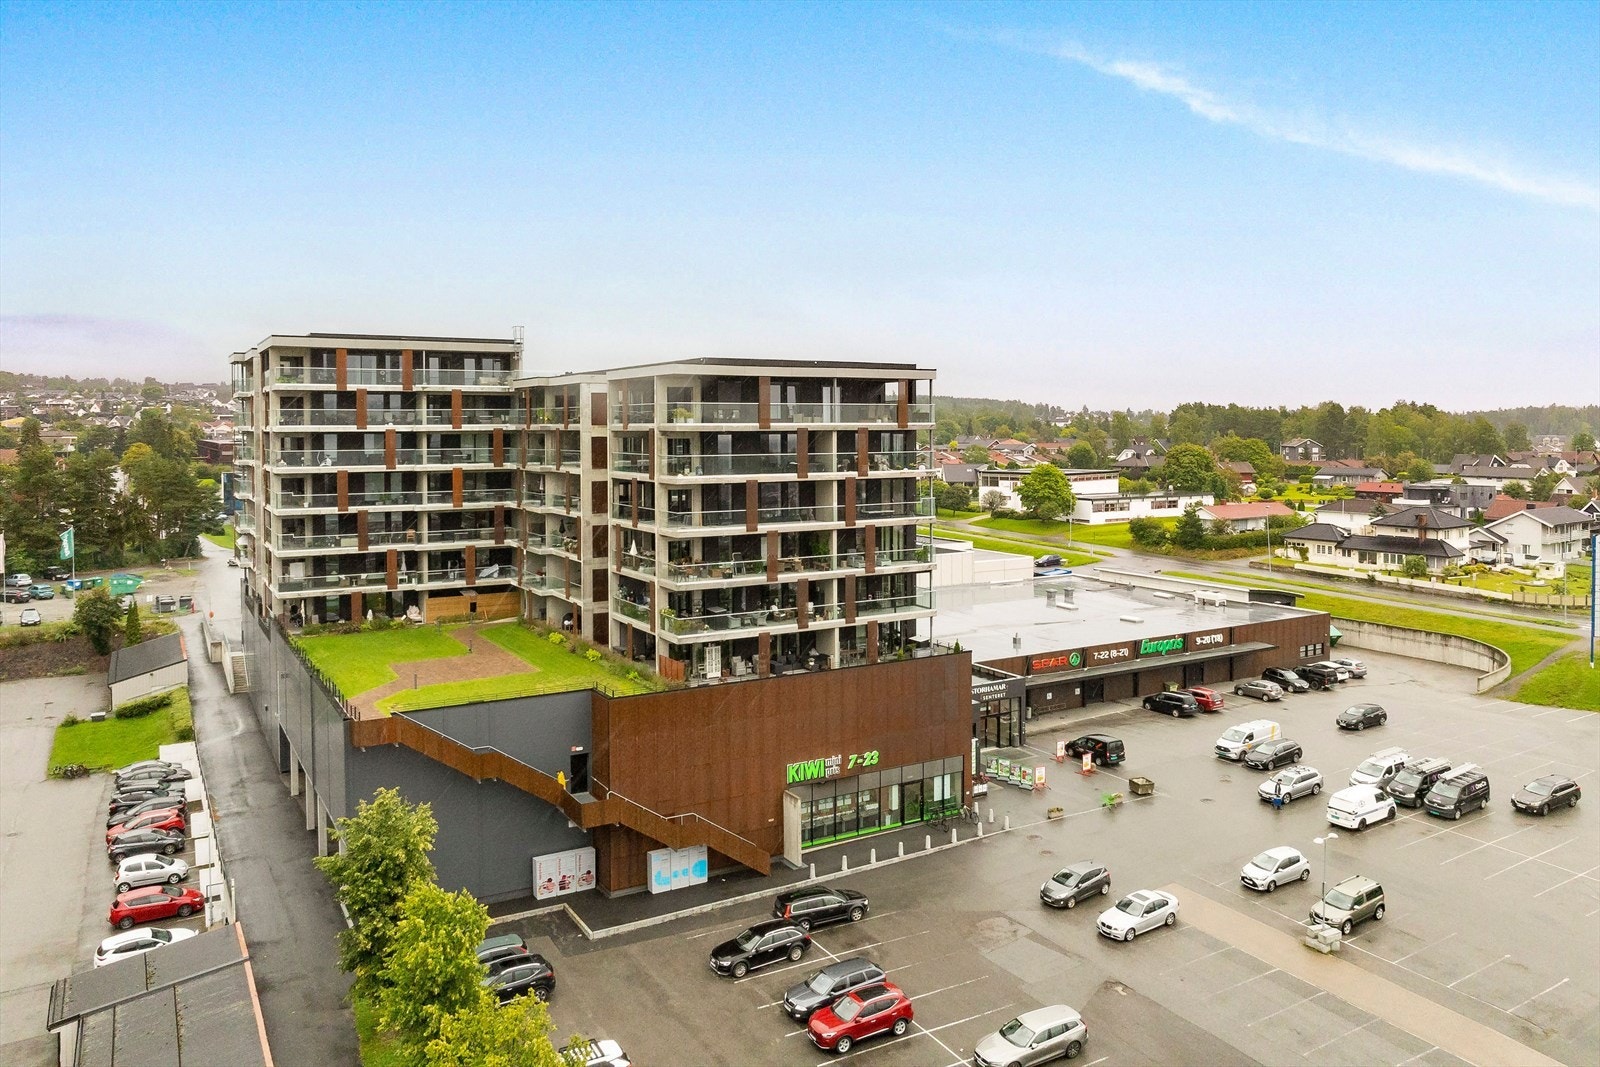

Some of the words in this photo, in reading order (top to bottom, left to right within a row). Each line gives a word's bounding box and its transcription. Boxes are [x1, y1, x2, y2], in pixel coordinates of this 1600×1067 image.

[1141, 635, 1184, 656] Europris
[1093, 651, 1110, 660] 7-22
[1110, 648, 1129, 659] (8-21)
[1032, 656, 1068, 670] SPAR
[982, 692, 1007, 701] SENTERET
[825, 754, 842, 767] mini
[847, 750, 879, 770] 7-23
[787, 758, 825, 784] KIWI
[825, 765, 841, 778] pris
